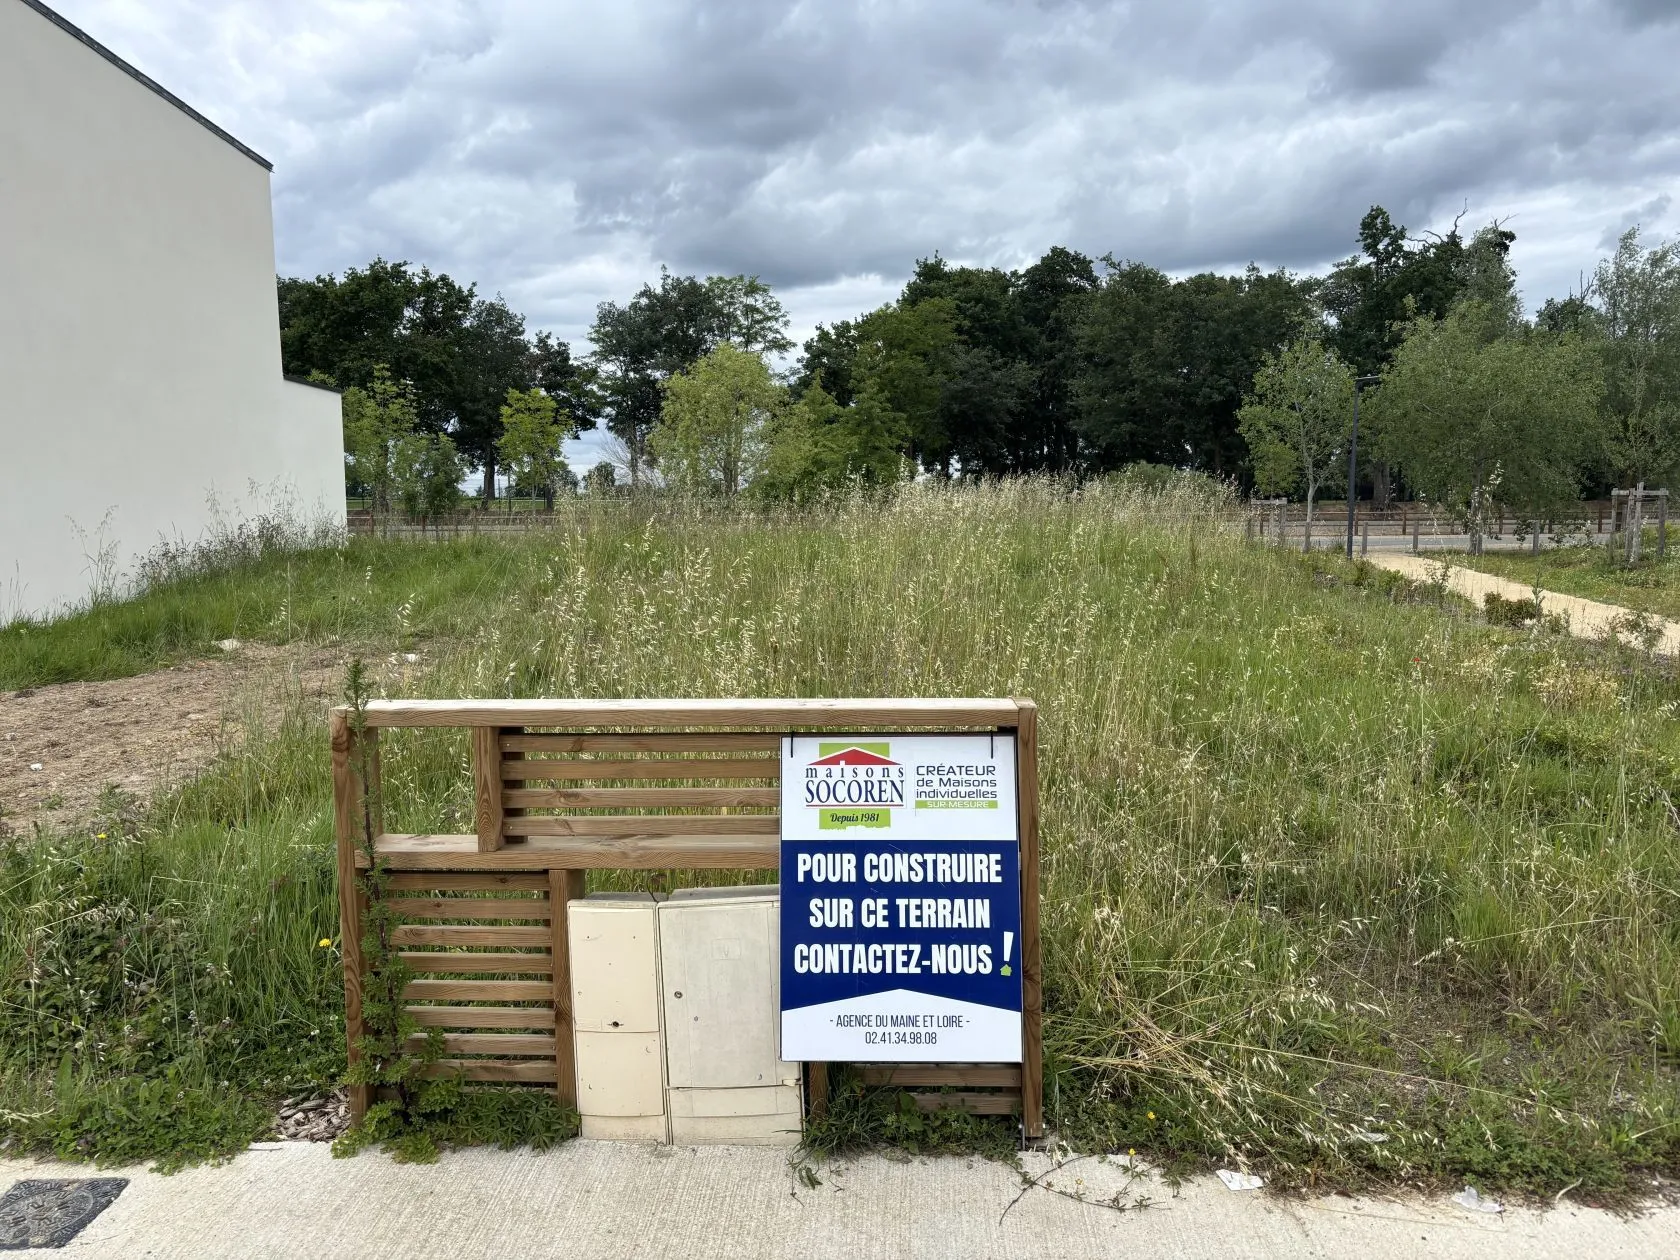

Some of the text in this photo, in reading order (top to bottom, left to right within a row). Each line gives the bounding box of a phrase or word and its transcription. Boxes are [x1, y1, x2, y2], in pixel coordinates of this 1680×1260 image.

[805, 766, 904, 778] maisons
[916, 763, 996, 776] CRÉATEUR
[916, 777, 997, 788] de Maisons
[805, 780, 905, 804] SOCOREN
[916, 788, 997, 799] individuelles
[927, 800, 989, 808] SUR MESURE
[830, 812, 880, 823] Depuis 1981
[797, 853, 1003, 883] POUR CONSTRUIRE
[809, 898, 991, 928] SUR CE TERRAIN
[794, 943, 993, 975] CONTACTEZ-NOUS
[836, 1015, 873, 1027] AGENCE
[875, 1015, 888, 1027] DU
[890, 1015, 921, 1027] MAINE
[922, 1015, 934, 1027] ET
[937, 1015, 963, 1027] LOIRE
[865, 1032, 937, 1044] 02.41.34.98.08
